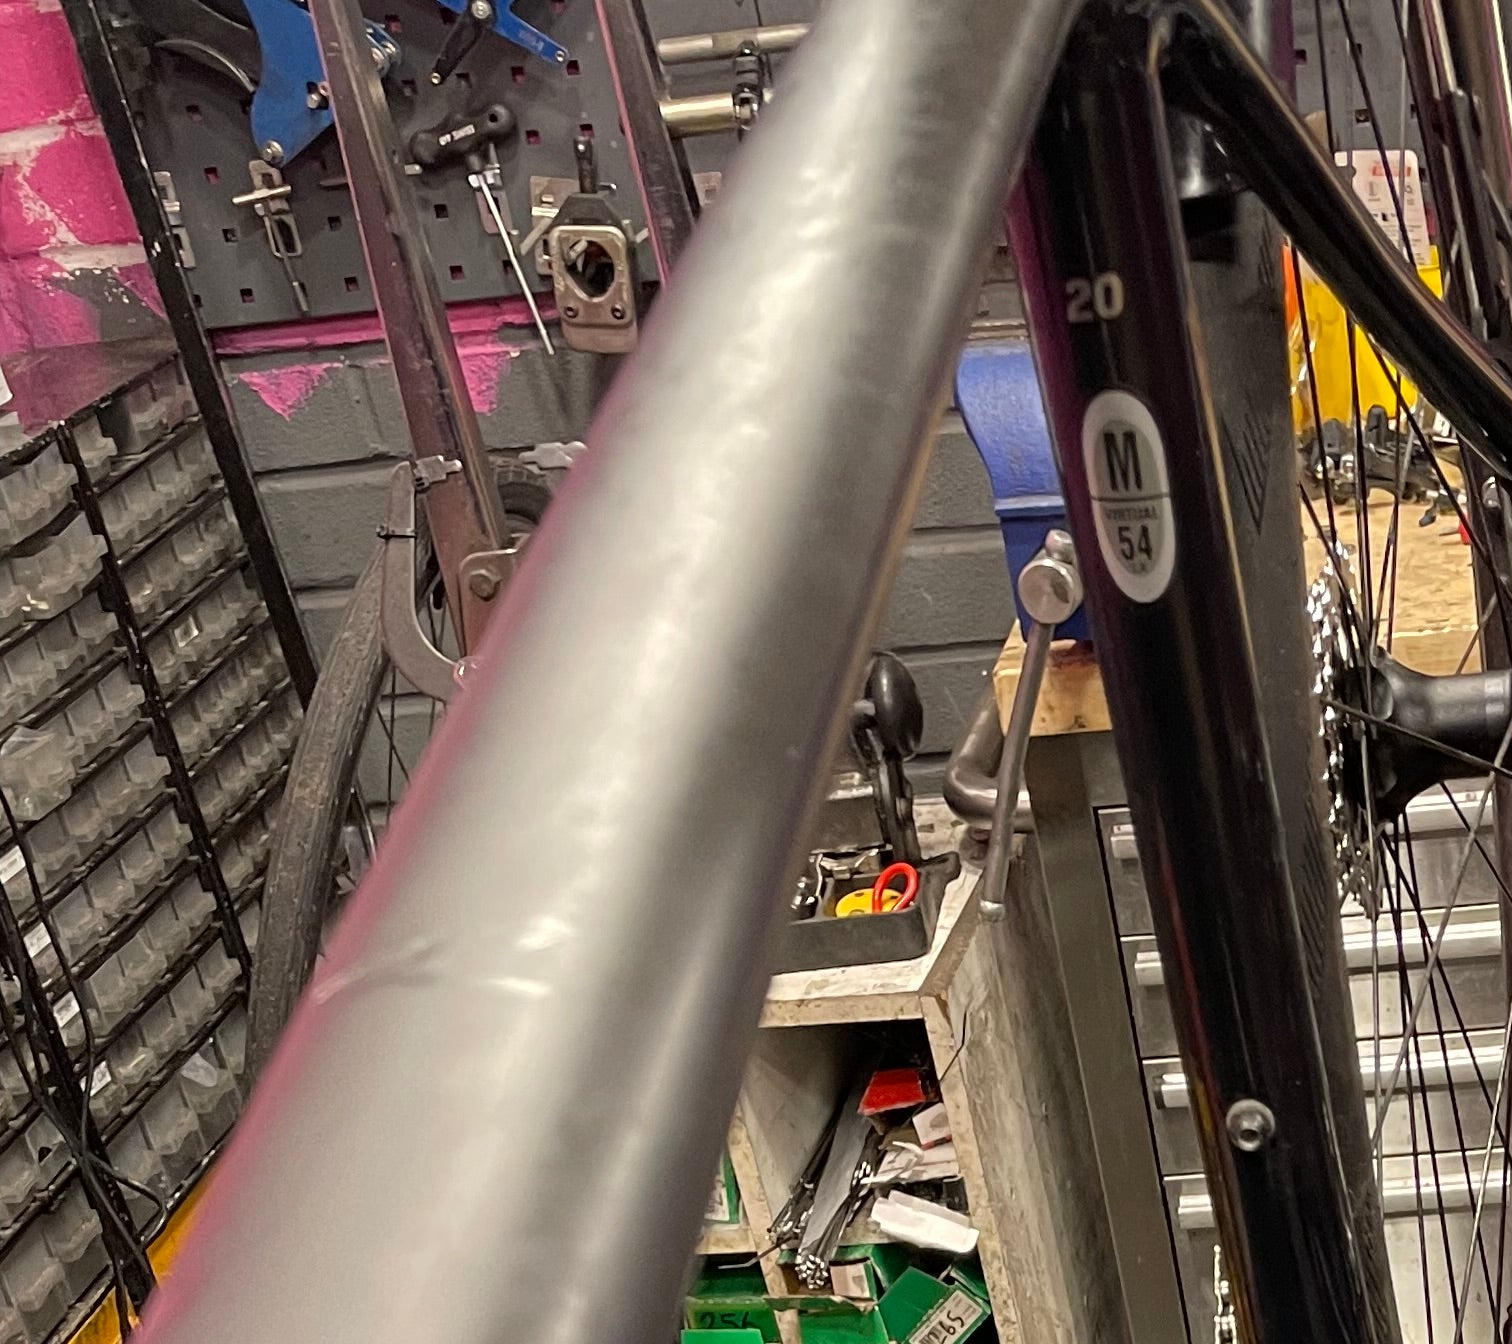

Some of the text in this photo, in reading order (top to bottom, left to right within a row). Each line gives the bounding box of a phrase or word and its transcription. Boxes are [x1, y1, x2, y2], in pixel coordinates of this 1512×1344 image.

[1065, 270, 1124, 323] 20
[1103, 432, 1142, 492] M
[1118, 524, 1153, 561] 54
